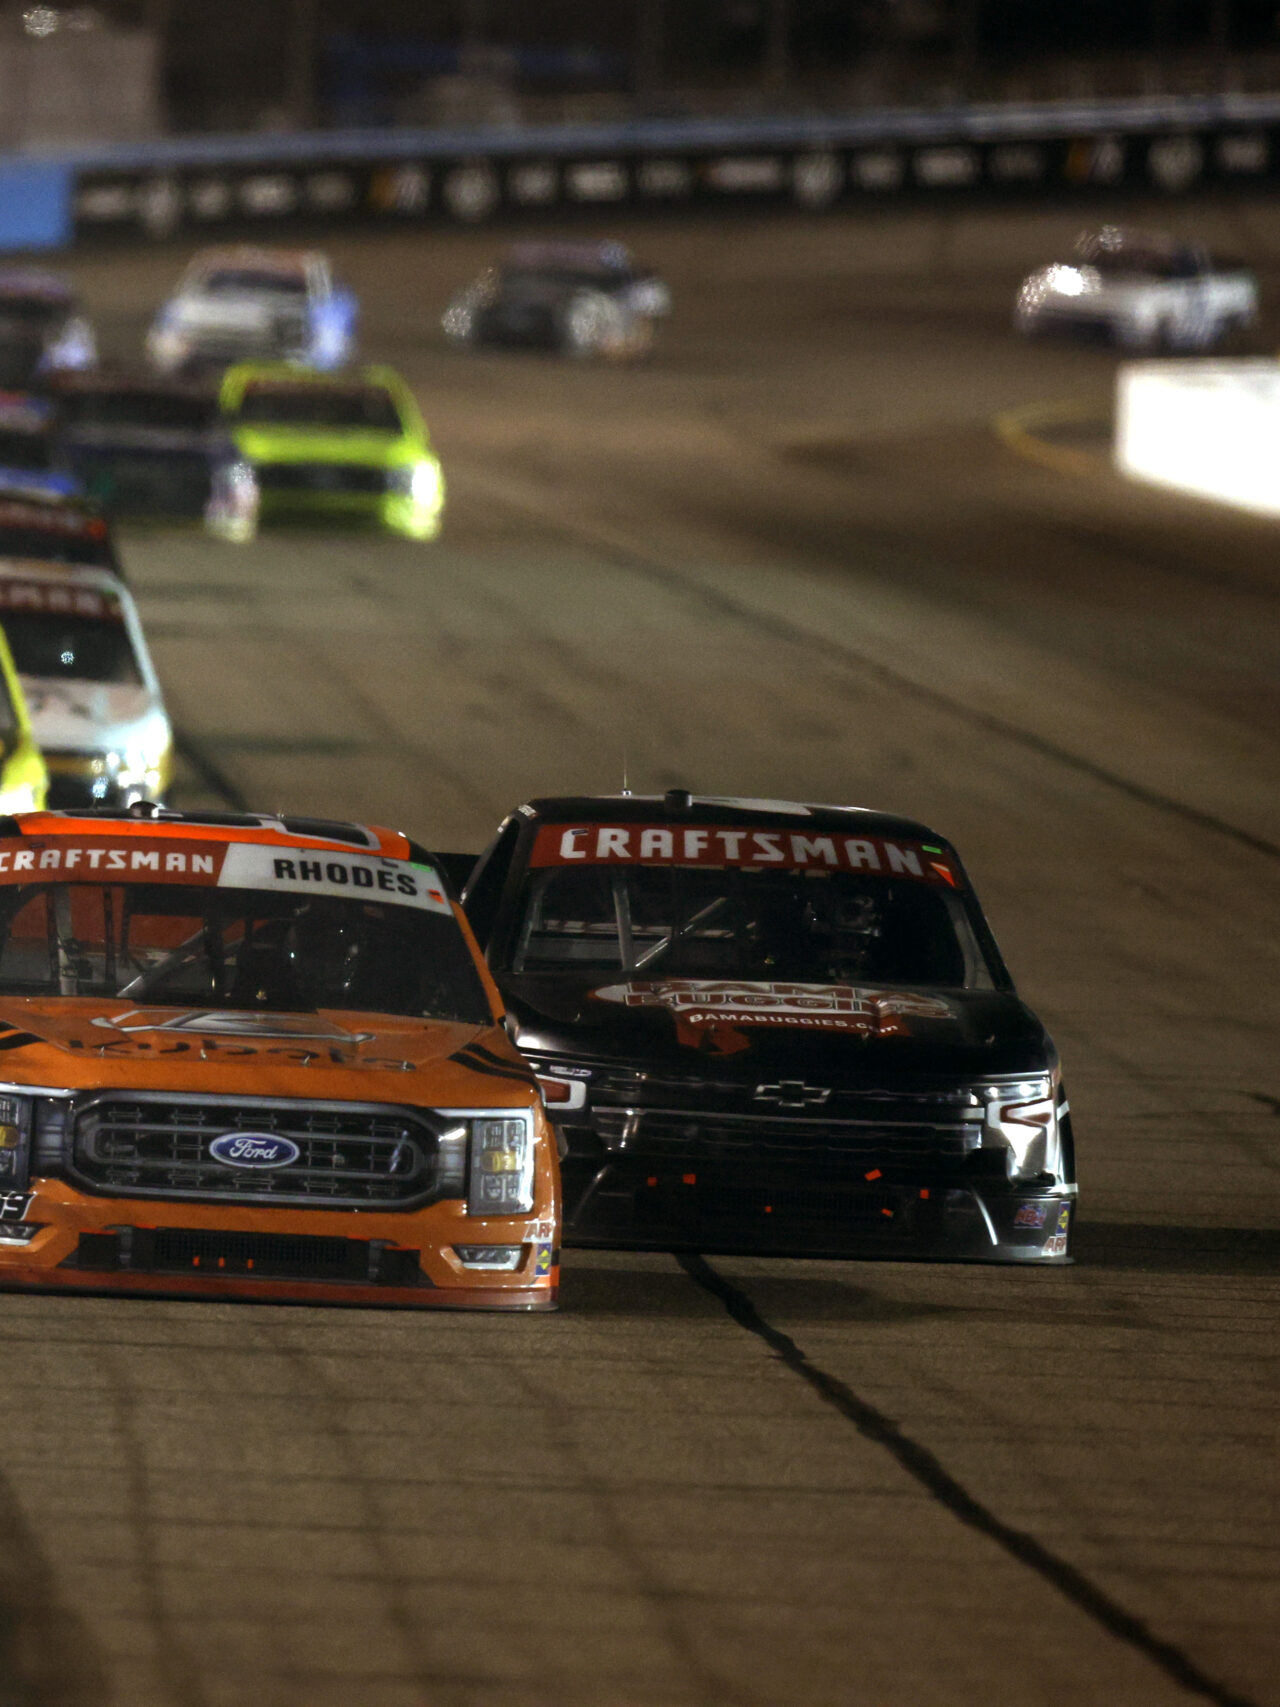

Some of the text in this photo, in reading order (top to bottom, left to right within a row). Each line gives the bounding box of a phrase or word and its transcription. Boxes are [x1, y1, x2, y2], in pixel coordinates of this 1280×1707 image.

[560, 826, 923, 876] CRAFTSMAN
[273, 858, 419, 896] RHODES
[229, 1138, 278, 1160] Ford
